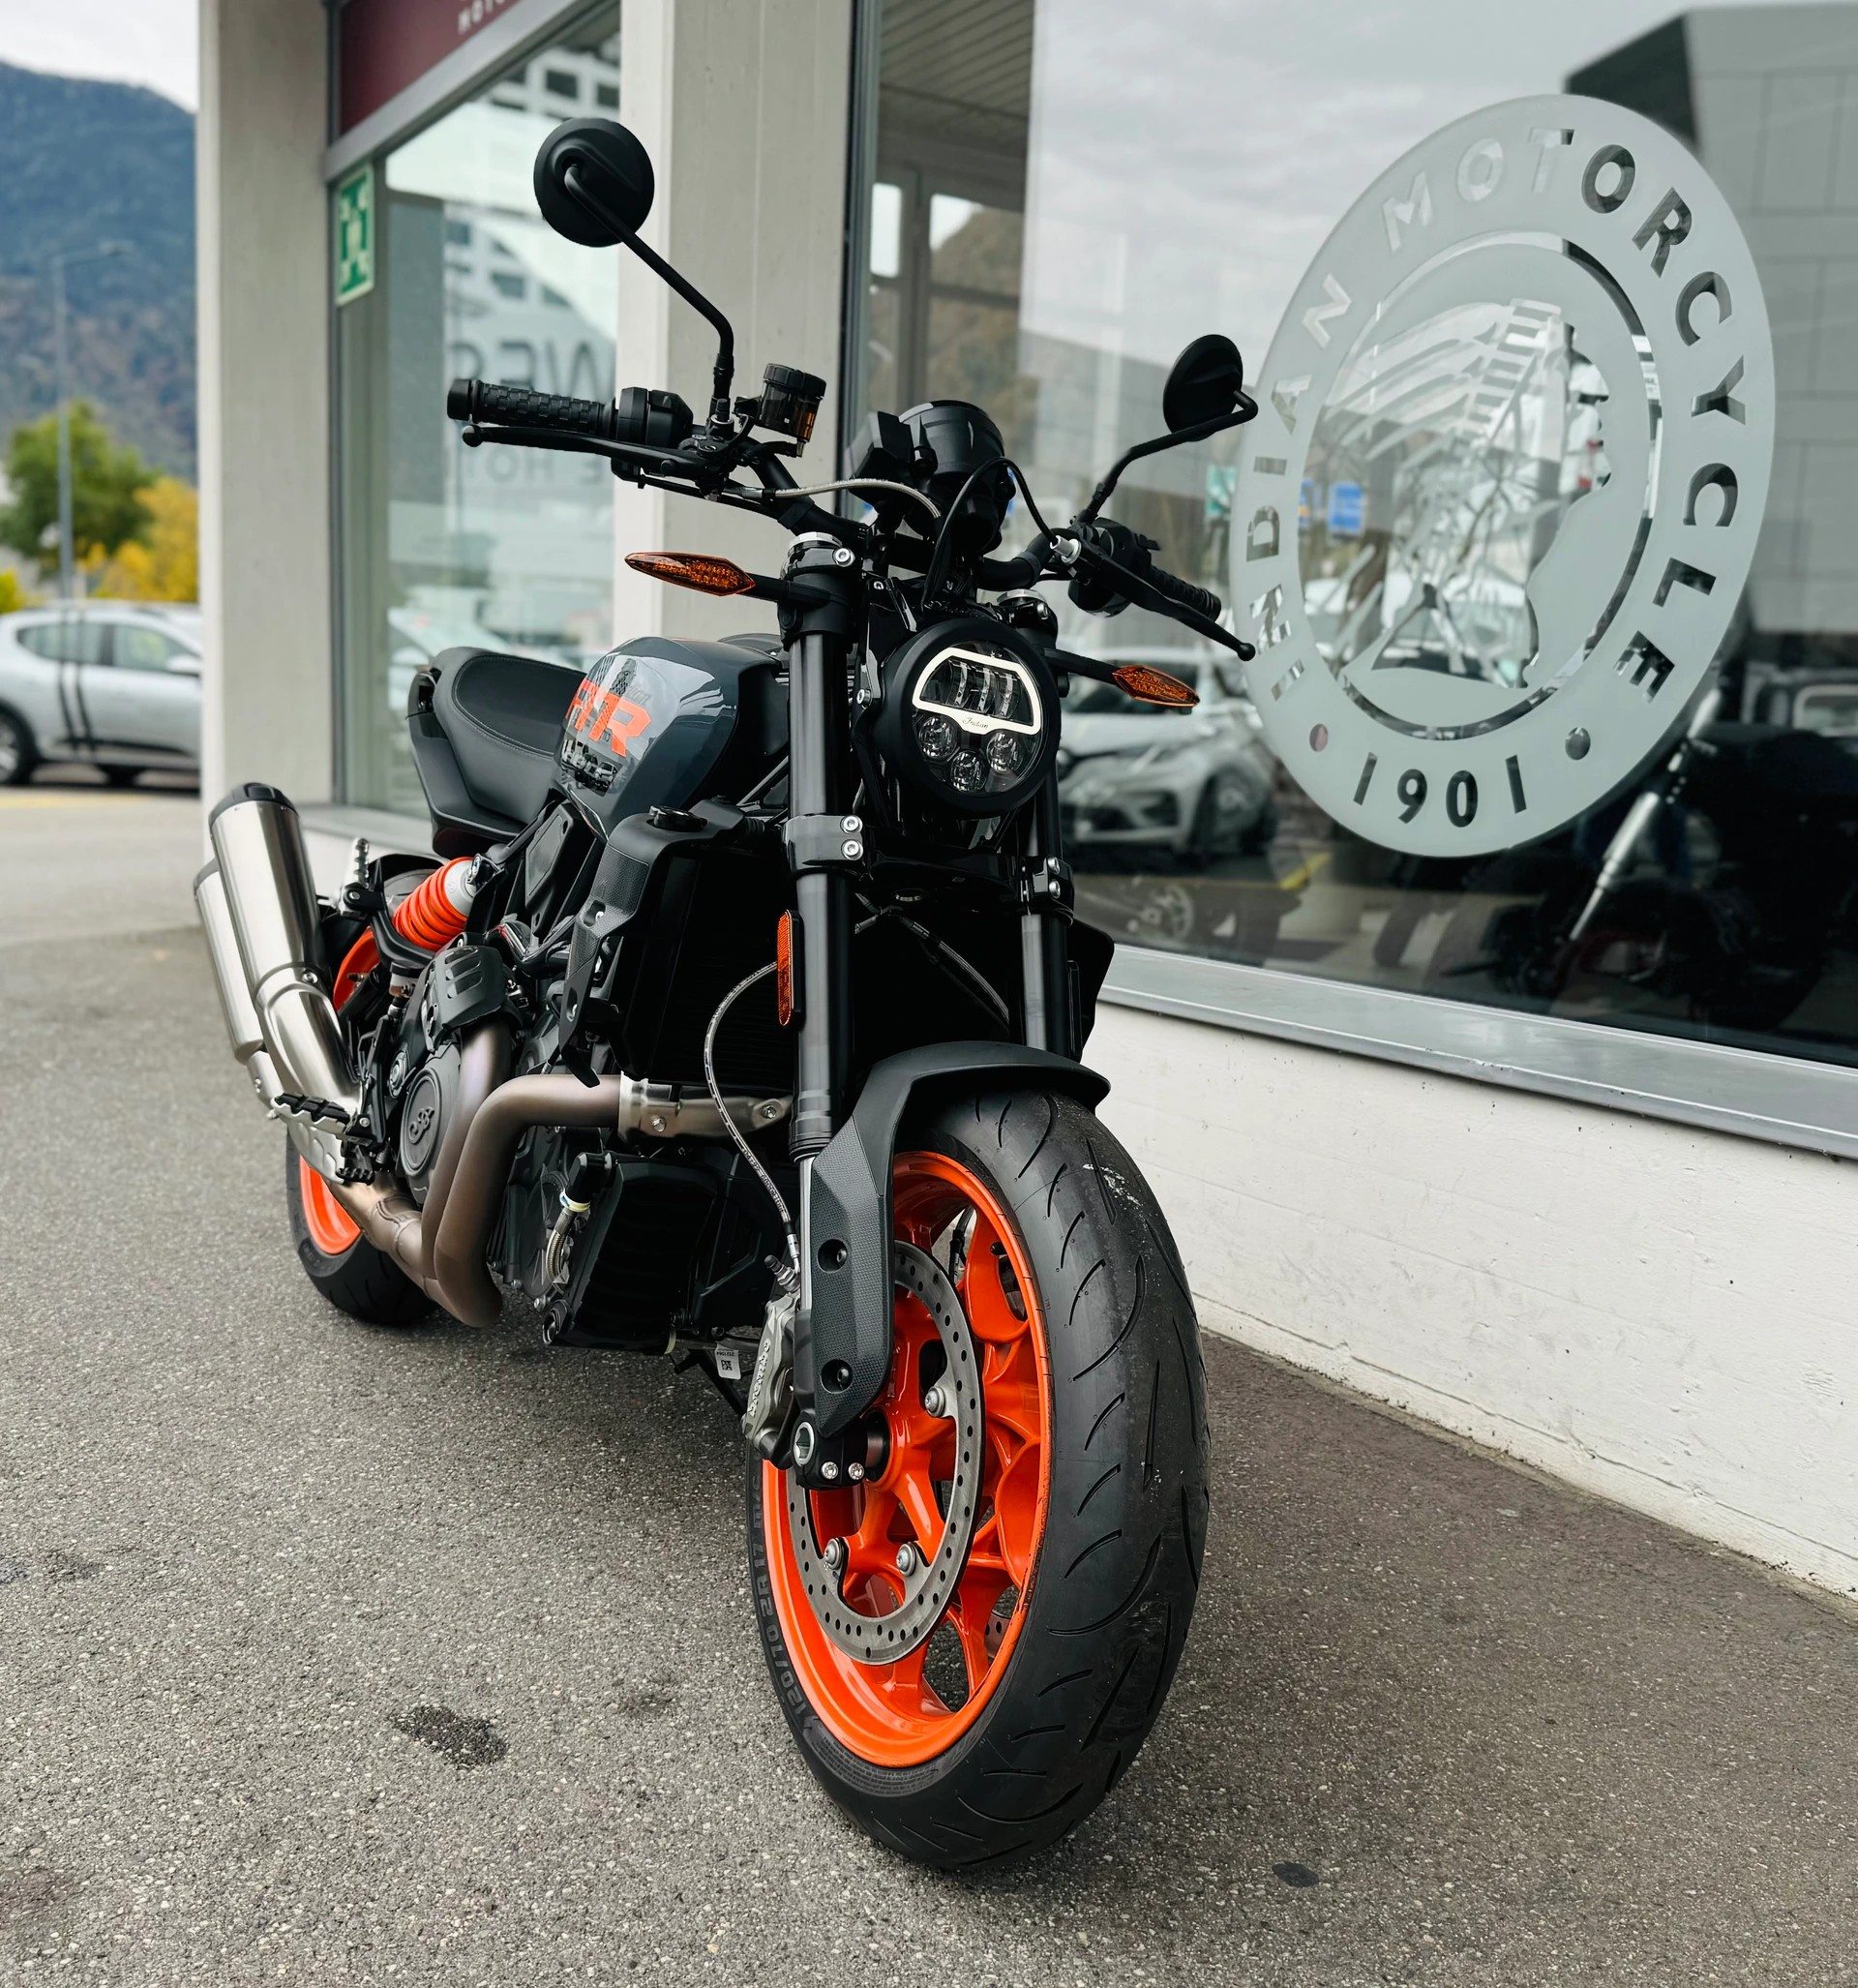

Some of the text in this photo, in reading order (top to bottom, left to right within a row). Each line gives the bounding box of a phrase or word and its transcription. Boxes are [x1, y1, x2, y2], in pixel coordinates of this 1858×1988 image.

[1245, 127, 1747, 704] INDIAN MOTORCYCLE
[1353, 751, 1527, 828] 1901
[746, 1338, 771, 1418] brembo
